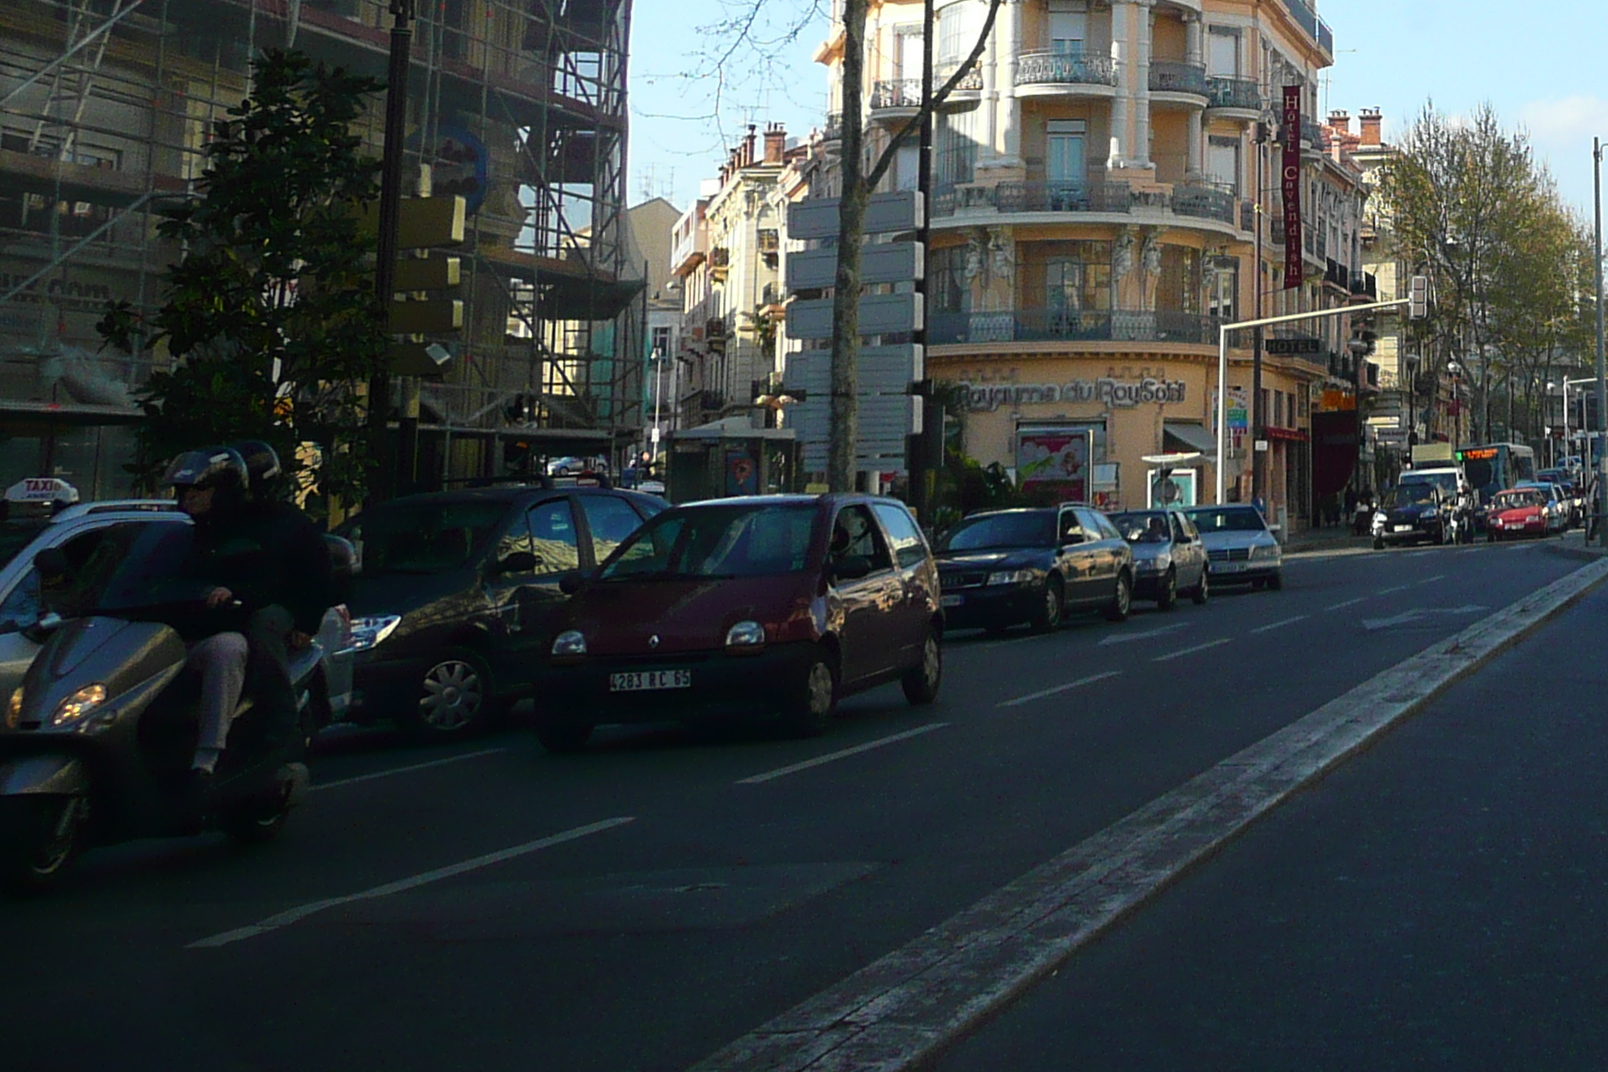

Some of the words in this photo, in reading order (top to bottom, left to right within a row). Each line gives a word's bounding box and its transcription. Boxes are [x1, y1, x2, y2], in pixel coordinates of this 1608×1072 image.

[1284, 166, 1299, 276] Cavendish
[1267, 340, 1317, 353] HOTEL
[1064, 378, 1093, 401] du
[25, 480, 54, 492] TAXI
[611, 673, 642, 690] 4283
[649, 672, 666, 687] RC
[674, 670, 690, 685] 65
